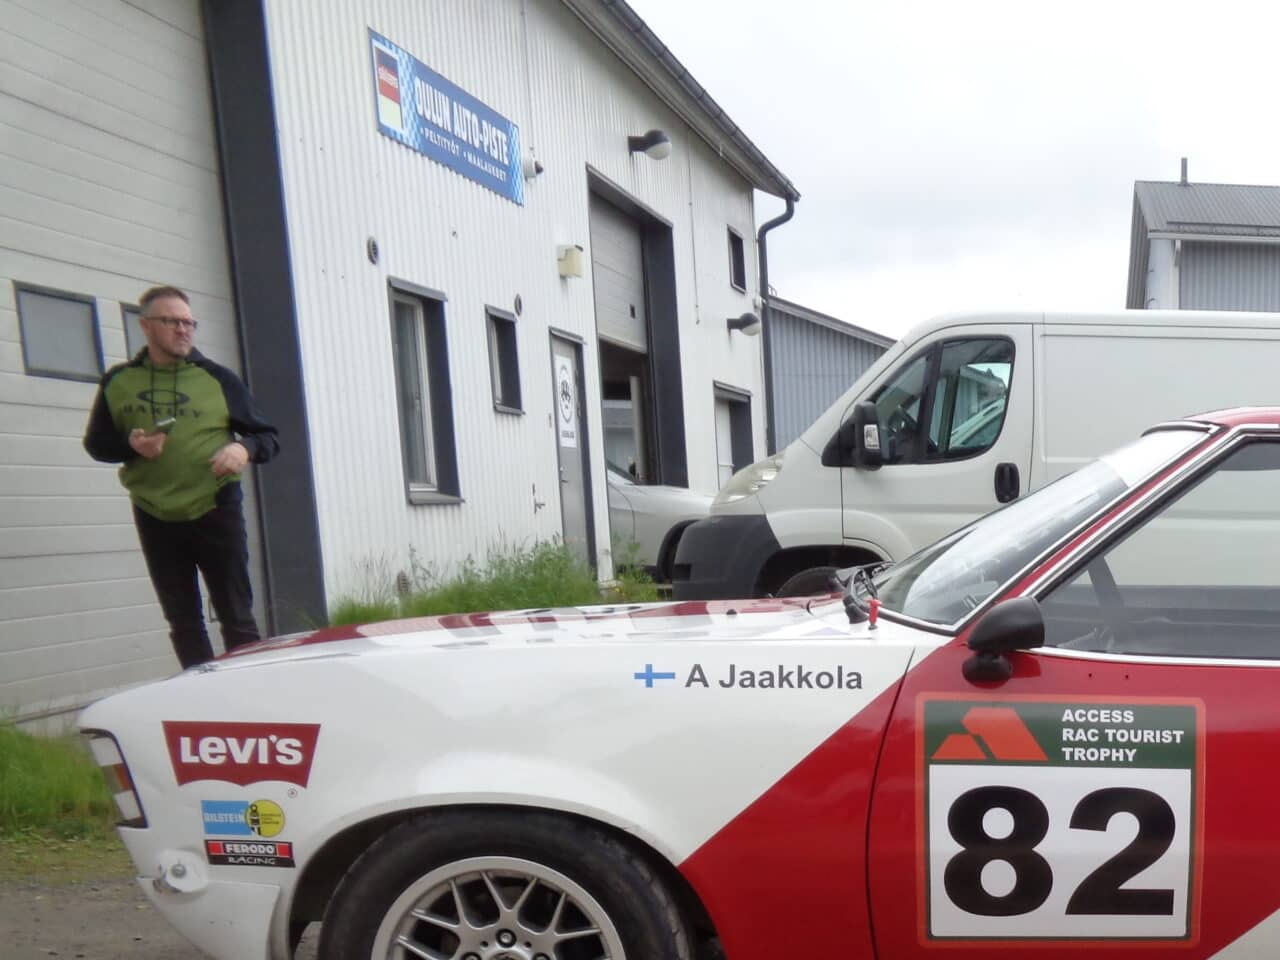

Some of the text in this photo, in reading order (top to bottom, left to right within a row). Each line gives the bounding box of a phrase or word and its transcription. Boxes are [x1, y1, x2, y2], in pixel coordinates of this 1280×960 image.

[414, 76, 509, 166] OULUN AUTO-PISTE
[685, 663, 863, 689] A Jaakkola
[1062, 709, 1135, 723] ACCESS
[1062, 728, 1185, 744] RAC TOURIST
[1062, 747, 1137, 762] TROPHY
[225, 843, 275, 854] FERODO
[943, 784, 1177, 917] 82
[227, 856, 276, 865] RACING
